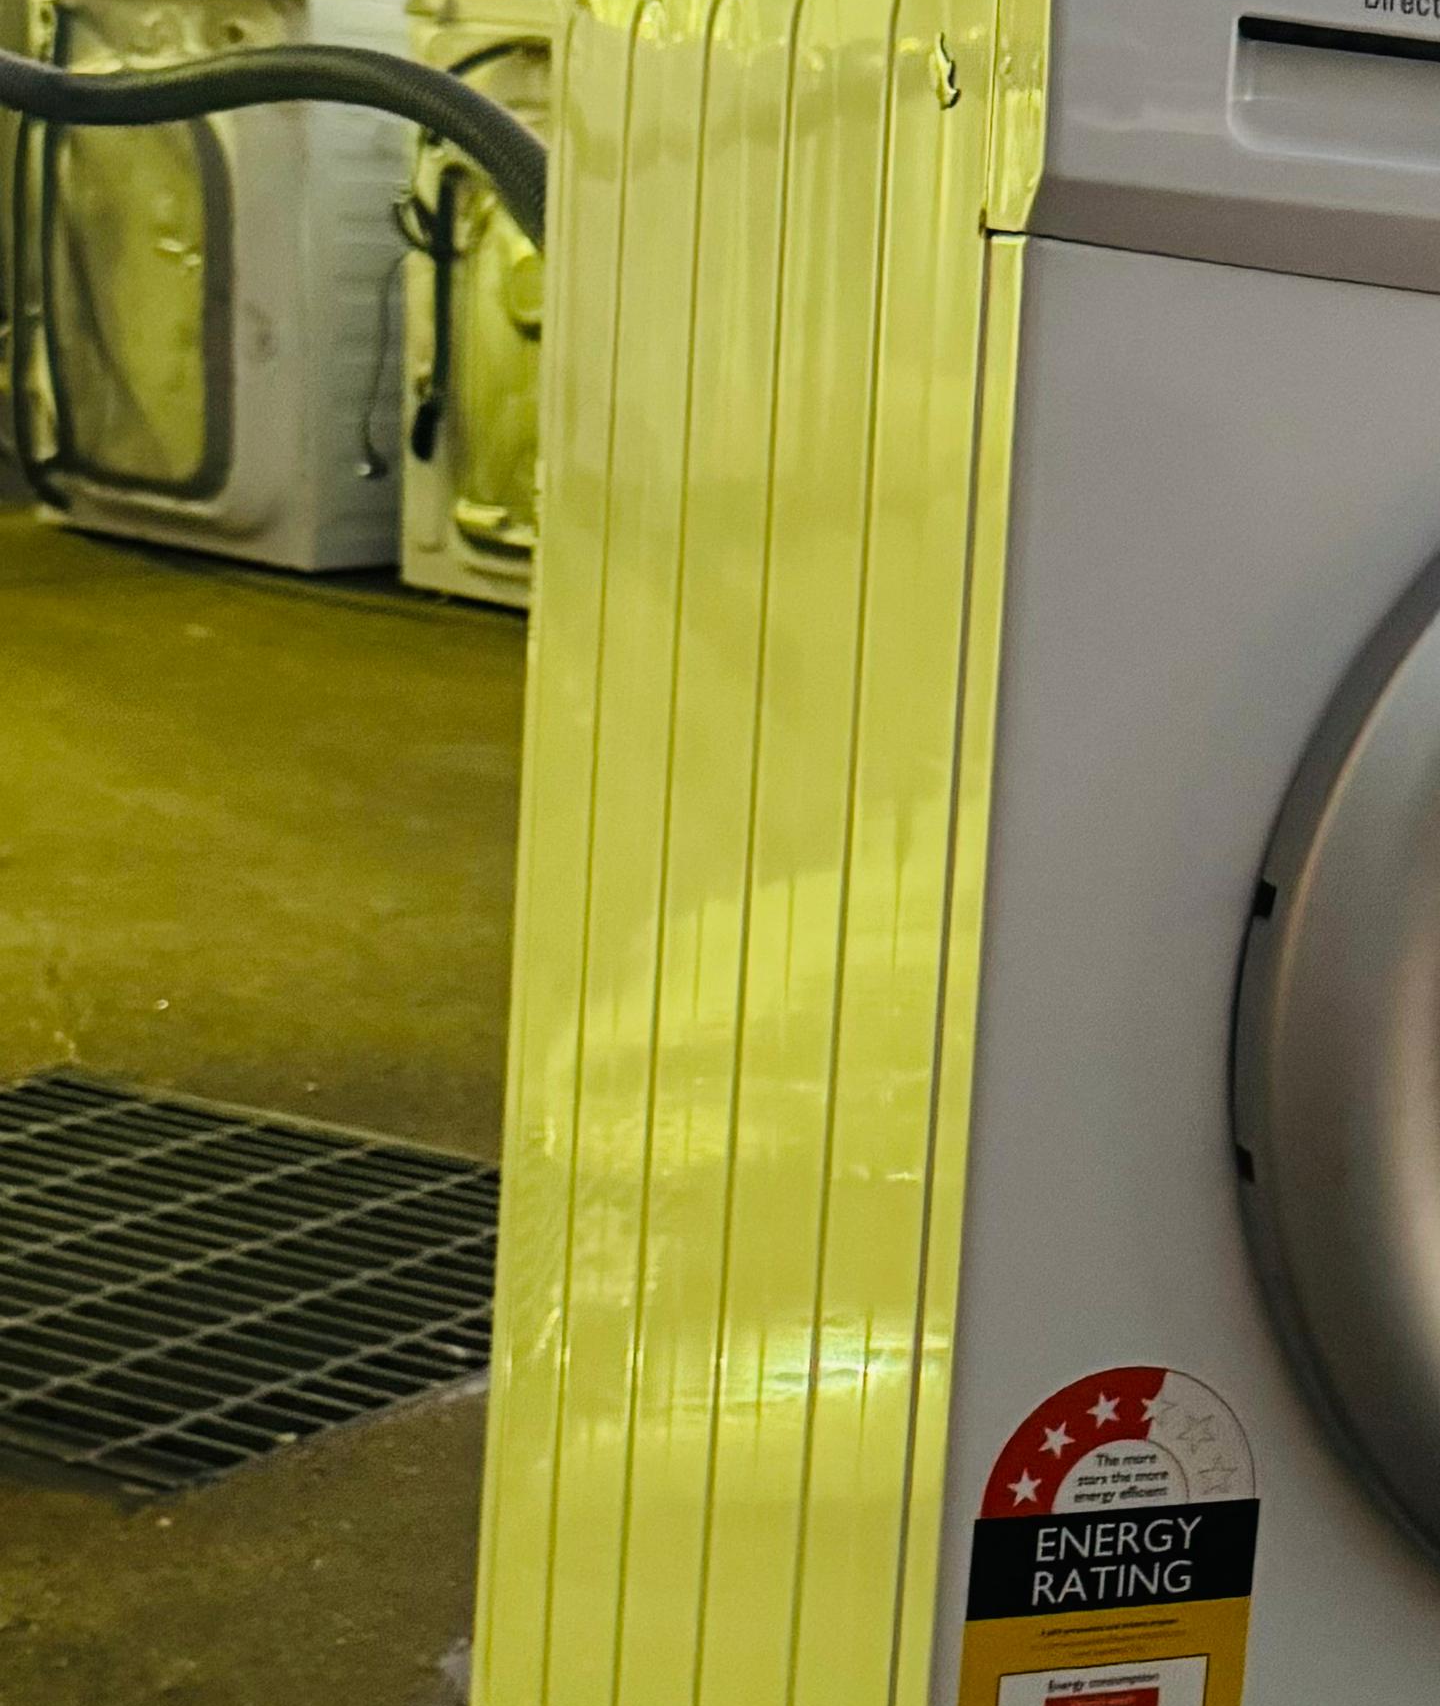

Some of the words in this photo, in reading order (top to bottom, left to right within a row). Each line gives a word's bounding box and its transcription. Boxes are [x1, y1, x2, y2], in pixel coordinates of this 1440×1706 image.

[1096, 1453, 1120, 1467] The
[1035, 1515, 1202, 1563] ENERGY
[1031, 1560, 1193, 1606] RATING
